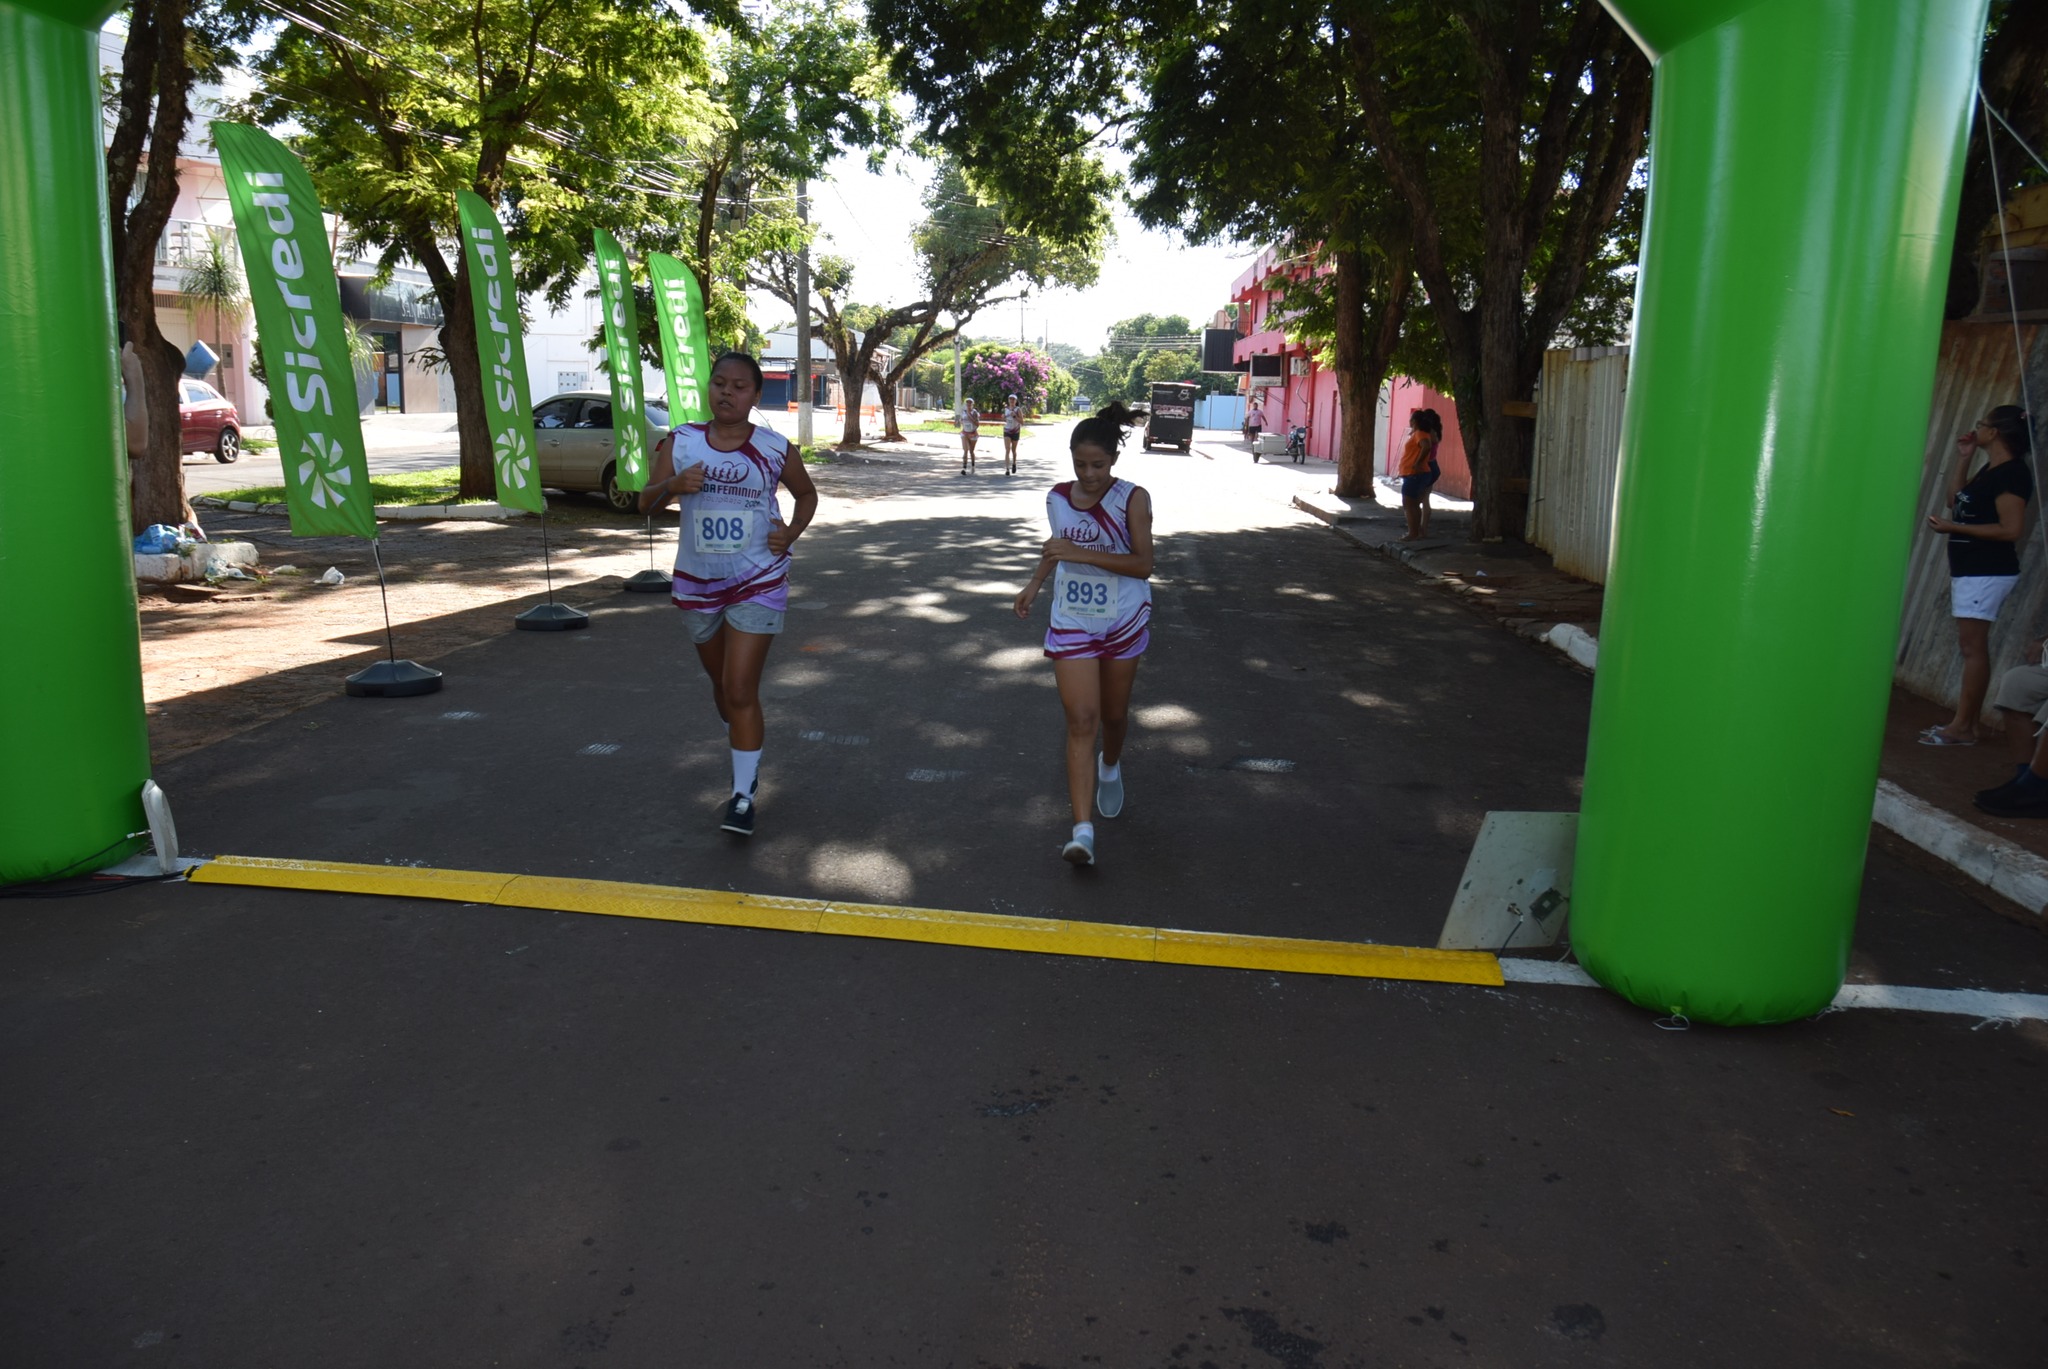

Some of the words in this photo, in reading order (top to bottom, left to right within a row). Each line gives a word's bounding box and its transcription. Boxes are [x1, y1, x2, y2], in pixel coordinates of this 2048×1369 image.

[244, 172, 333, 416] Sicredi
[472, 227, 520, 417] Sicredi
[604, 259, 636, 415] Sicredi
[664, 279, 702, 412] Sicredi
[702, 517, 744, 541] 808
[1066, 580, 1108, 605] 893
